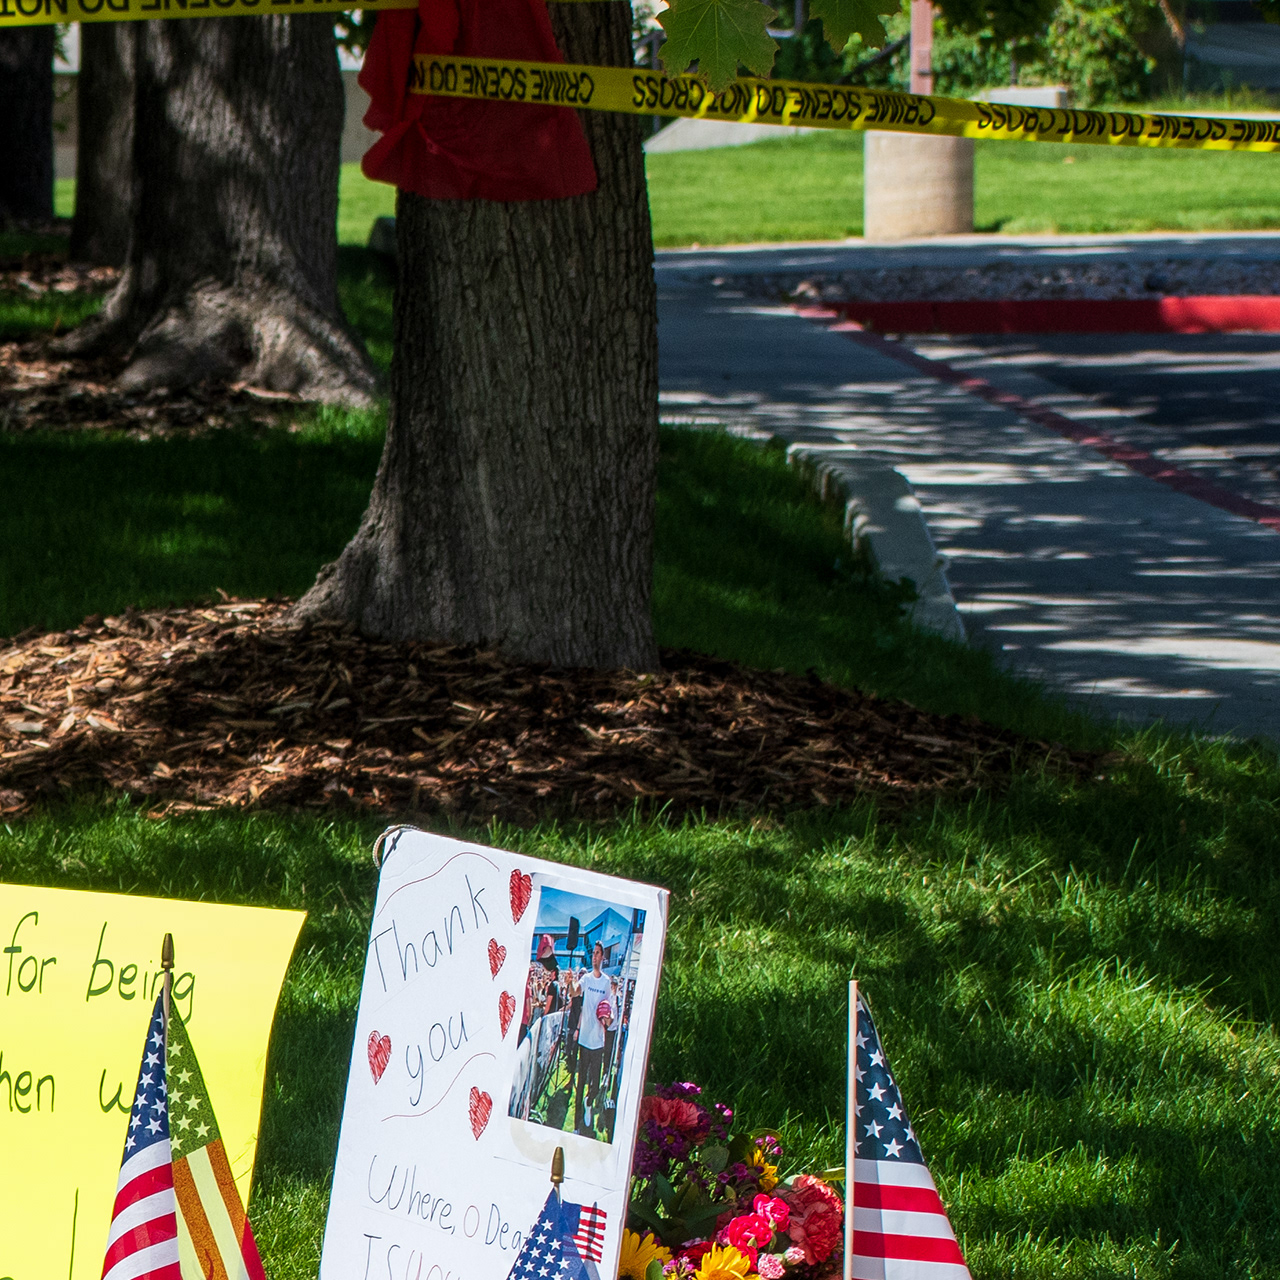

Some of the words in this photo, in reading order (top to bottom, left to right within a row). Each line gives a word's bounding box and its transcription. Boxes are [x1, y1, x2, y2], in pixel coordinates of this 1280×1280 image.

[429, 61, 457, 92] DO
[461, 64, 527, 100] SCENE
[531, 69, 594, 104] CRIME
[633, 75, 705, 113] CROSS
[757, 84, 785, 116] DO
[790, 87, 861, 121] SCENE
[865, 91, 935, 126] CRIME
[976, 102, 1055, 133] CROSS
[1057, 110, 1106, 136] NOT
[1110, 113, 1144, 138] DO
[1148, 116, 1227, 141] SCENE
[368, 873, 490, 993] Thank
[3, 911, 58, 996] for
[85, 921, 197, 1024] being
[404, 1010, 471, 1107] you
[99, 1066, 140, 1115] w
[367, 1153, 456, 1236] Where,
[484, 1202, 530, 1252] Dea
